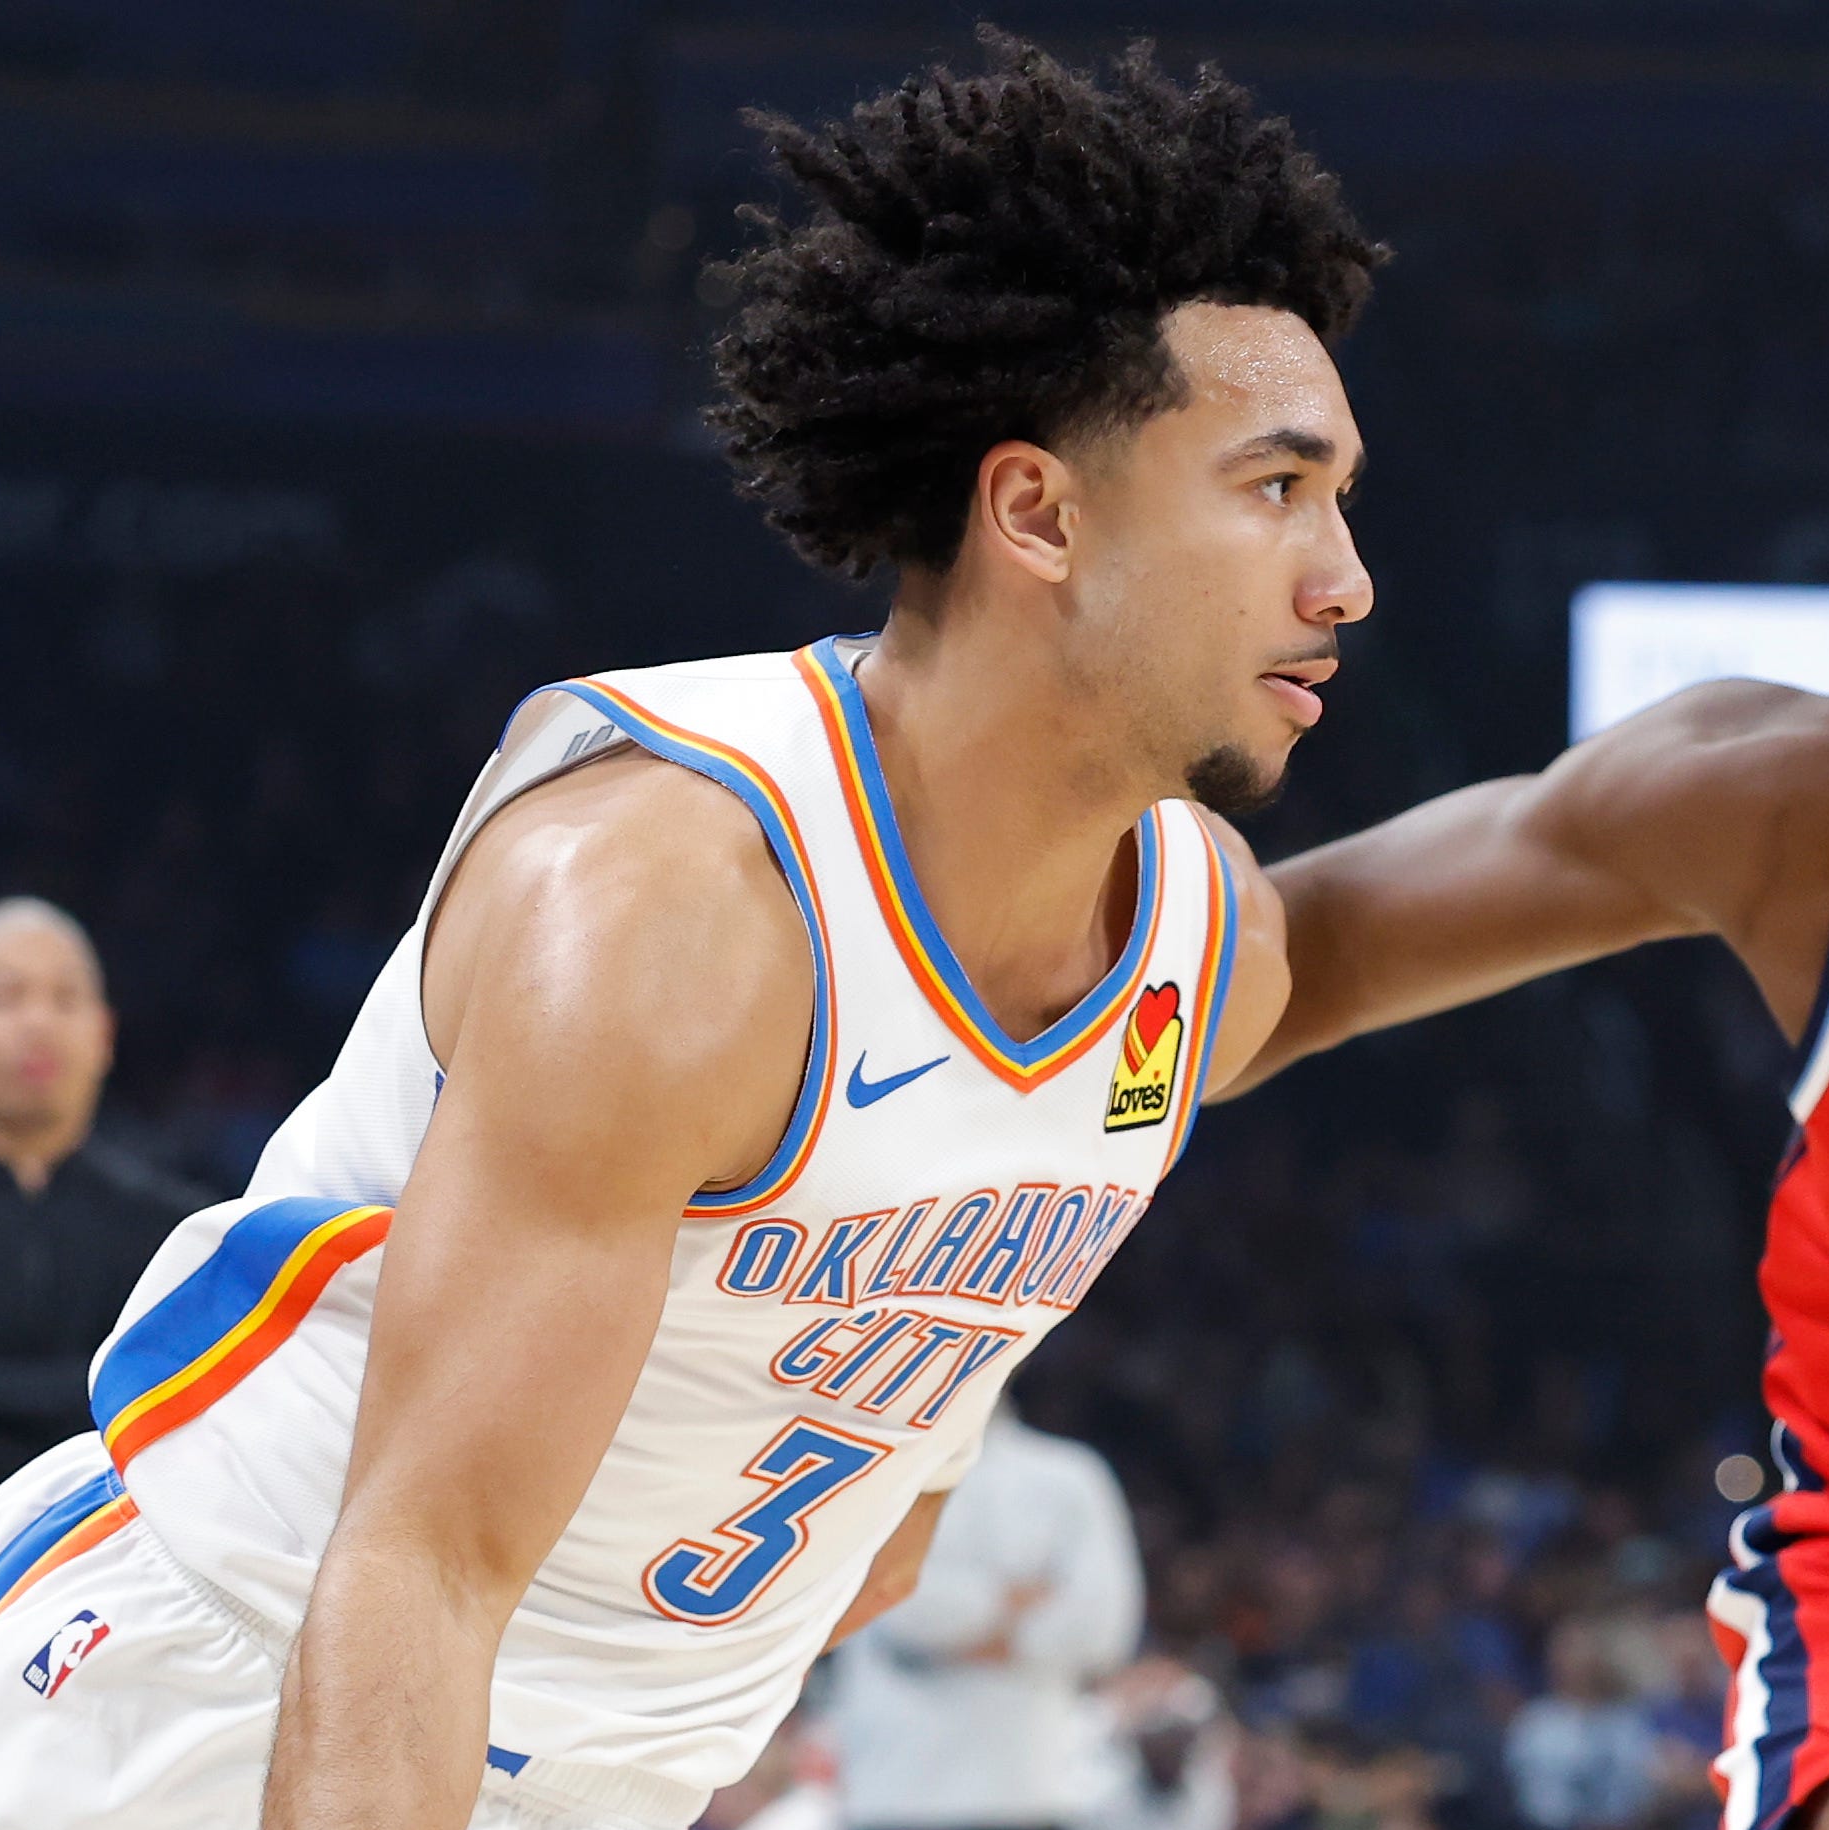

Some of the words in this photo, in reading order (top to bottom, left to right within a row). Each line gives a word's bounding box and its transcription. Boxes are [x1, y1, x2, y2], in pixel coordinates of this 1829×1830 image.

[716, 1183, 1154, 1312] OKLAHOM
[770, 1306, 1027, 1430] CITY
[641, 1414, 895, 1627] 3
